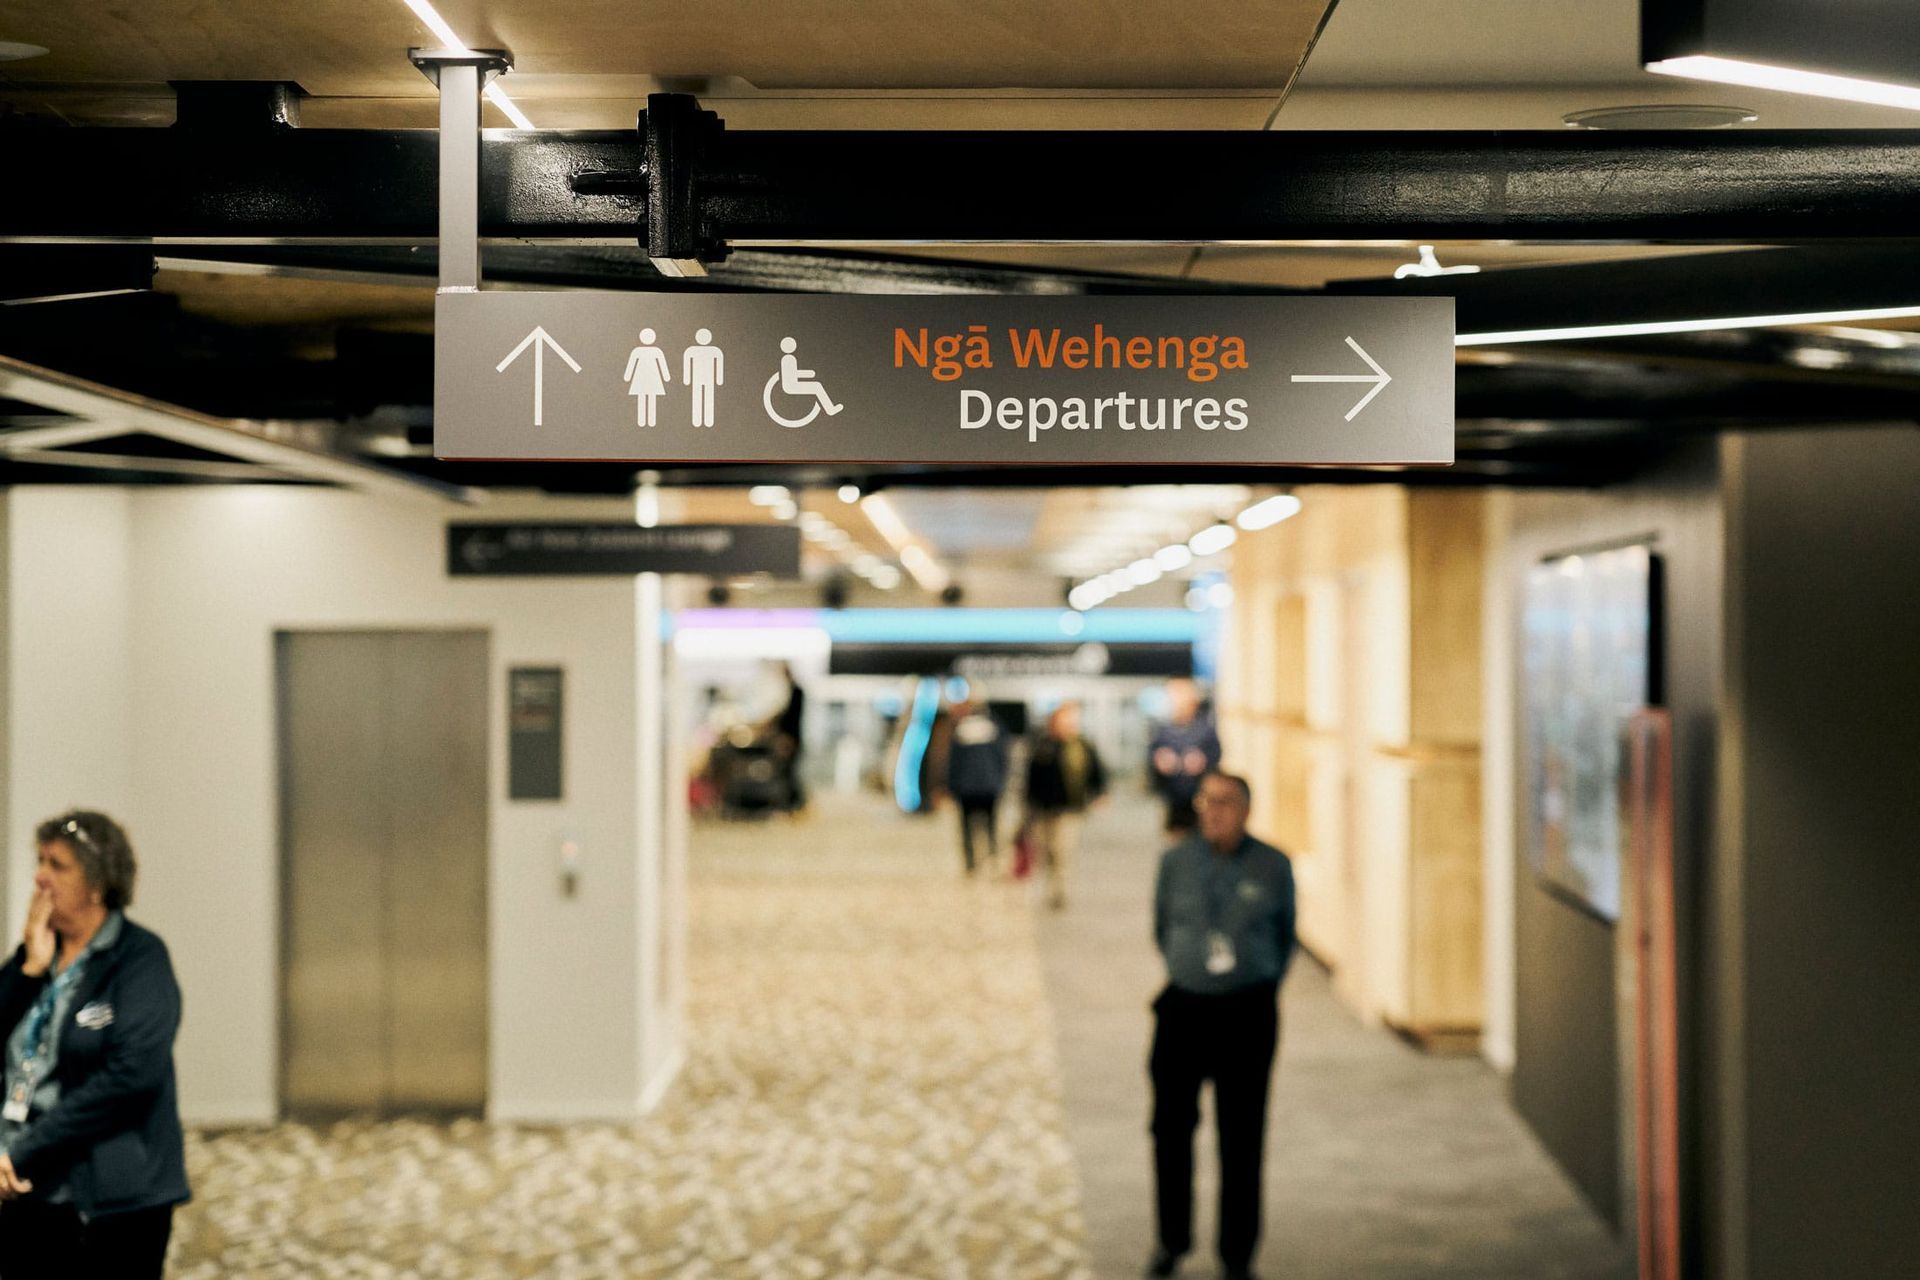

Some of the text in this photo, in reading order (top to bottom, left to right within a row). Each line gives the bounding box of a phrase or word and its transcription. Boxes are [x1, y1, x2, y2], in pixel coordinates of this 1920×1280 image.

[894, 324, 1248, 382] Ngā Wehenga
[960, 389, 1249, 442] Departures
